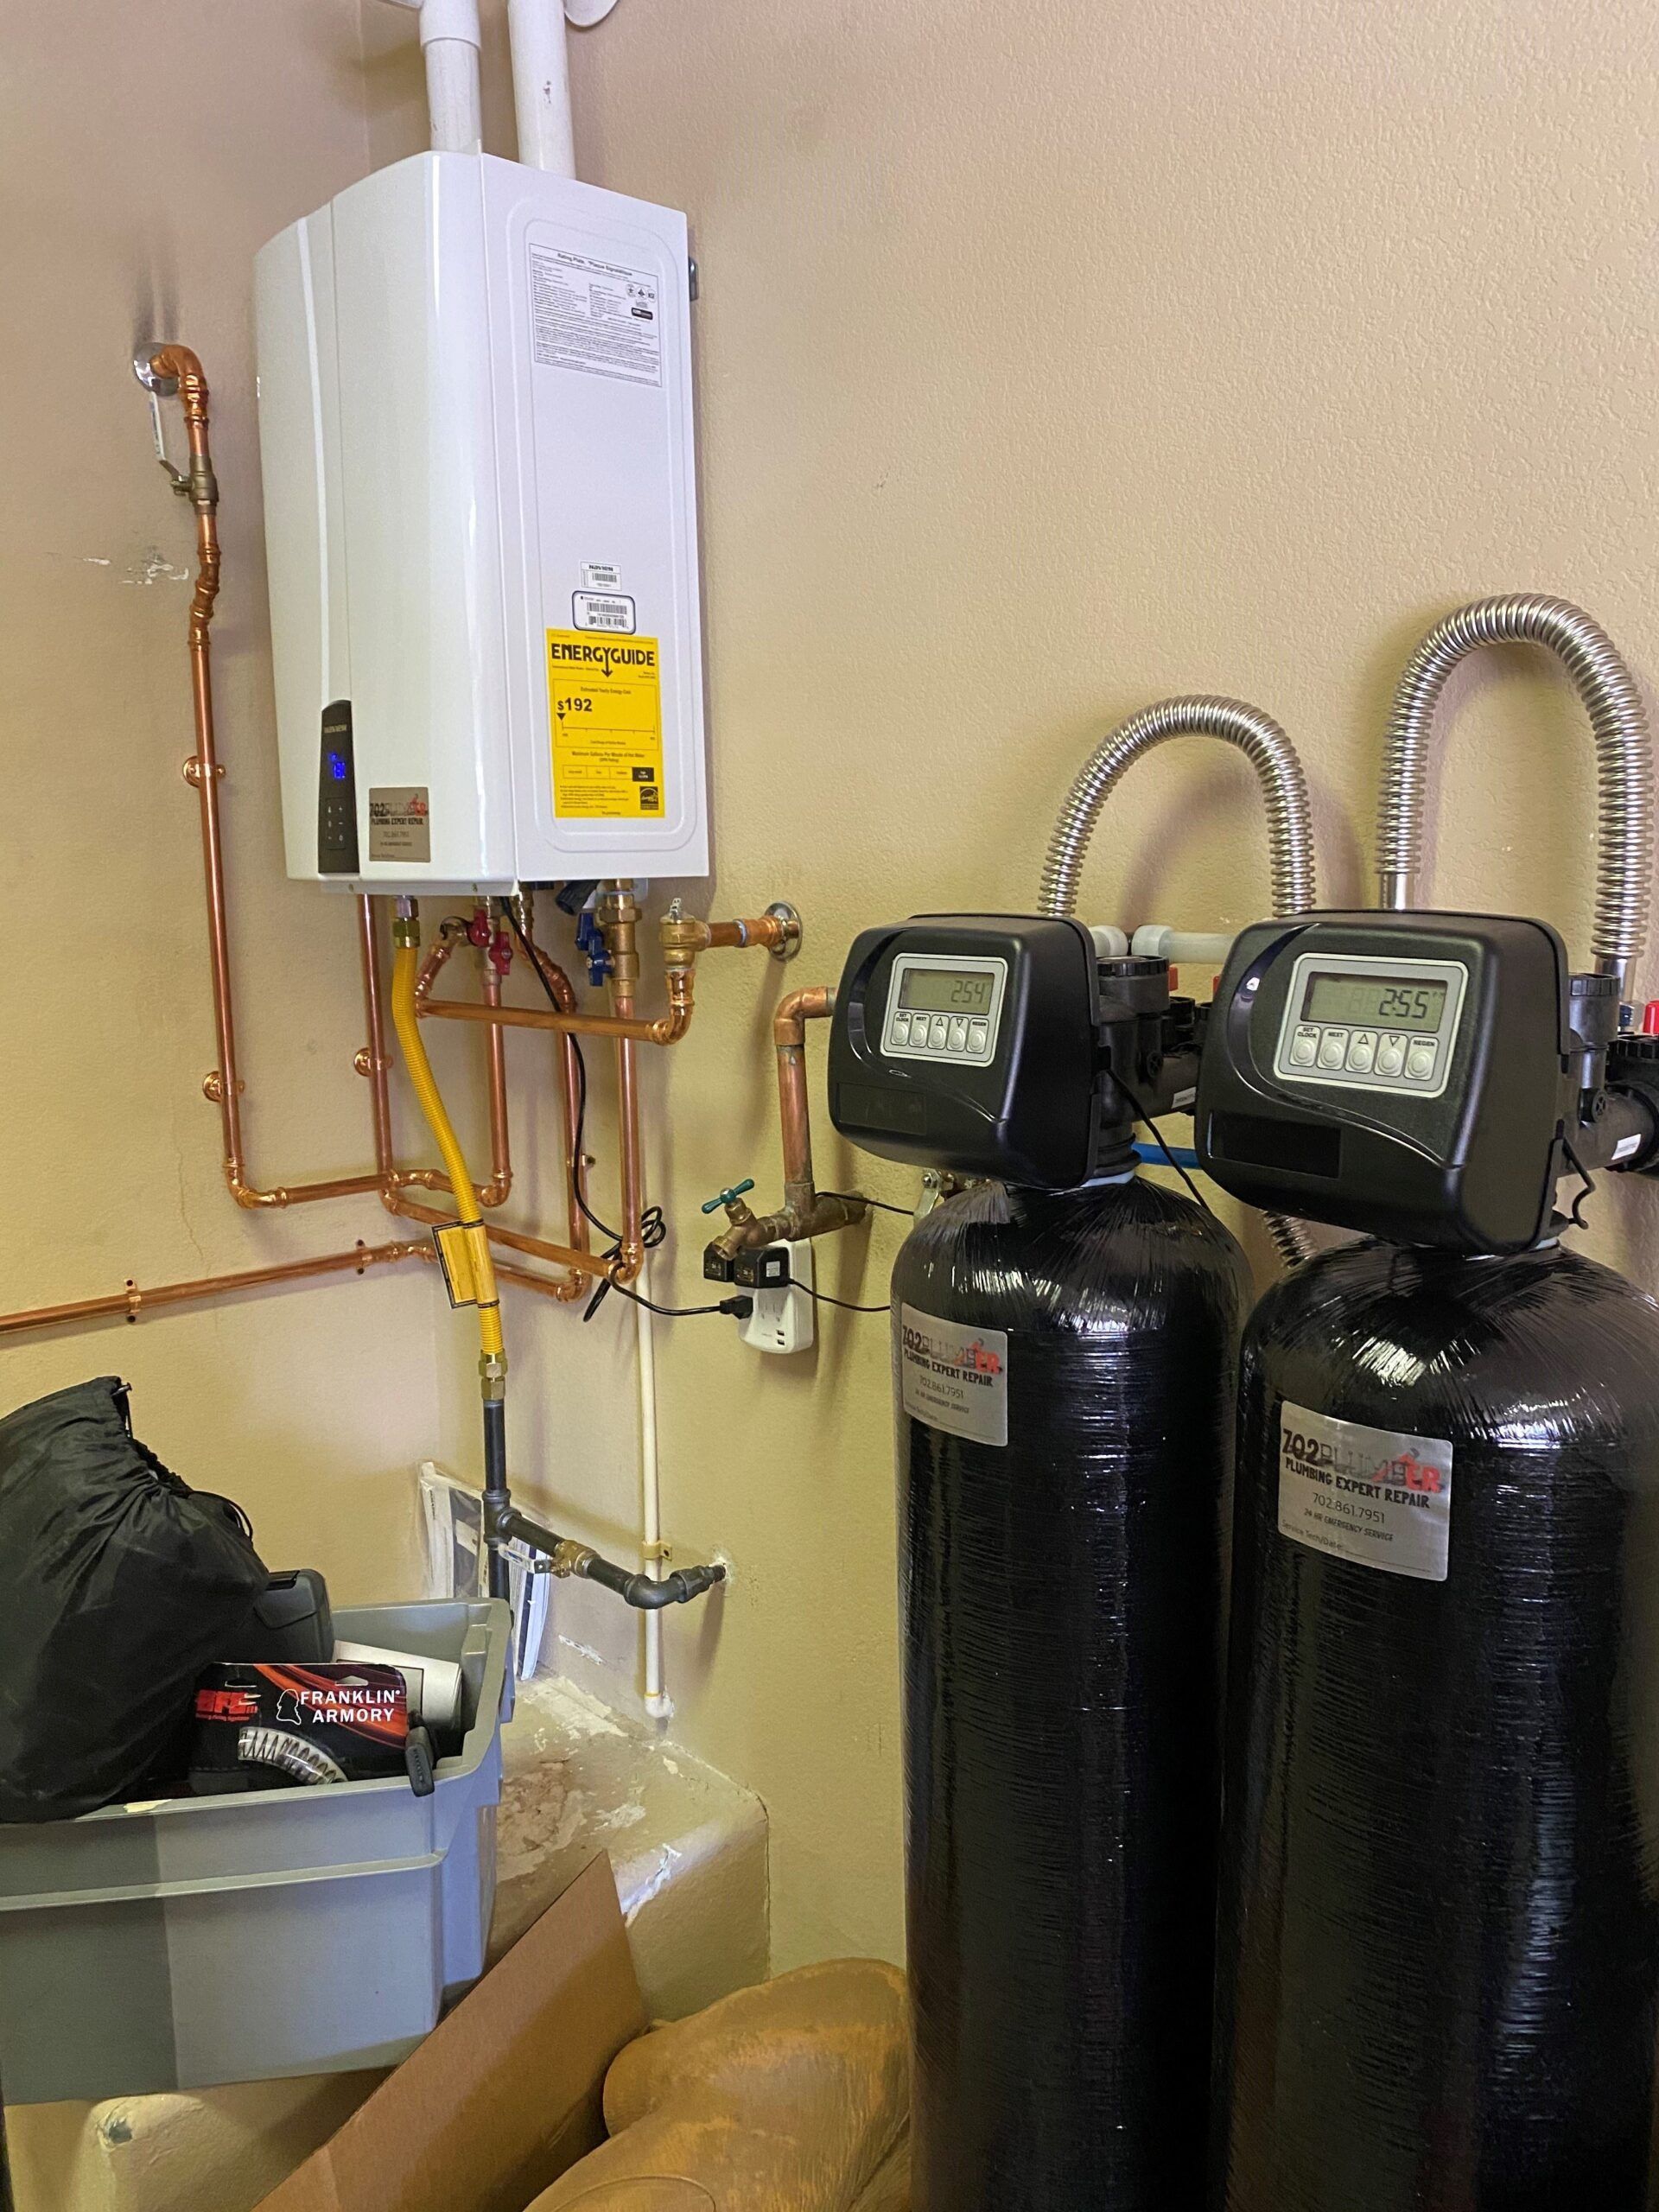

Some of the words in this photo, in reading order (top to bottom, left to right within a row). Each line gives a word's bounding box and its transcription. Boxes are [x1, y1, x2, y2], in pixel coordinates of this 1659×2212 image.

[551, 643, 655, 667] ENERGYGUIDE
[557, 697, 593, 712] $192
[931, 1363, 960, 1380] EXPERT
[963, 1370, 994, 1388] REPAIR
[1286, 1457, 1332, 1486] PLUMBING
[1336, 1476, 1381, 1500] EXPERT
[1385, 1489, 1431, 1509] REPAIR
[1324, 1516, 1362, 1534] EMERGENCY
[1363, 1528, 1395, 1541] SERVICE
[312, 1708, 395, 1723] ARMORY
